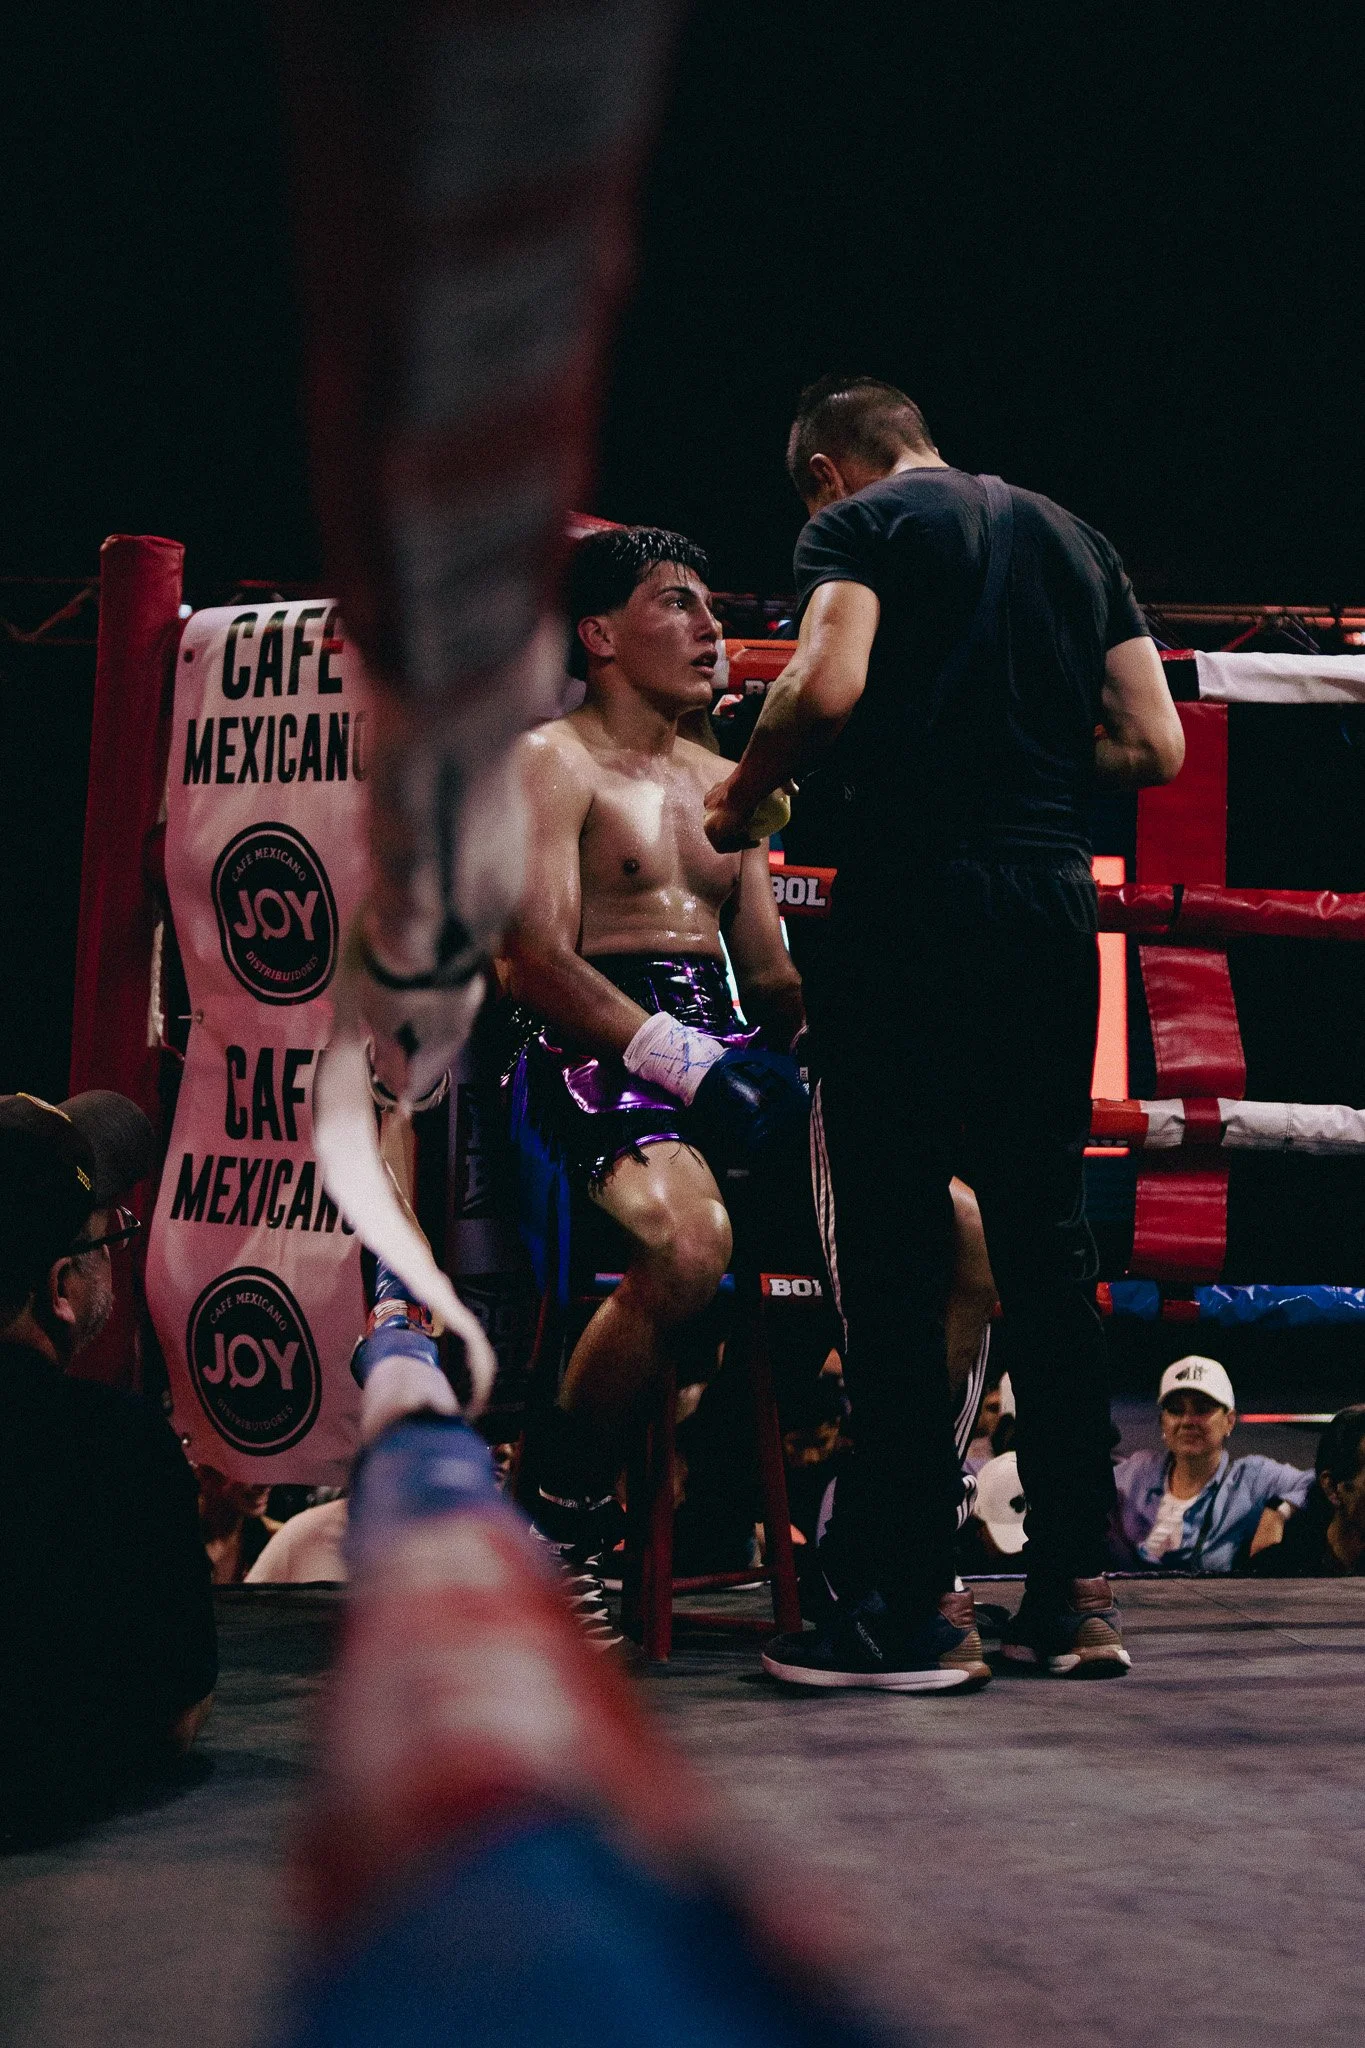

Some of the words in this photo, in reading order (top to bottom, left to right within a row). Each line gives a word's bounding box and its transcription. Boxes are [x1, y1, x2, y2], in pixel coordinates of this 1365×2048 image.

[255, 847, 307, 882] MEXICANO
[233, 888, 319, 941] JOY
[224, 1044, 322, 1142] CAF
[169, 1152, 355, 1236] MEXICAN
[235, 1292, 288, 1332] MEXICANO
[202, 1333, 300, 1391] JOY
